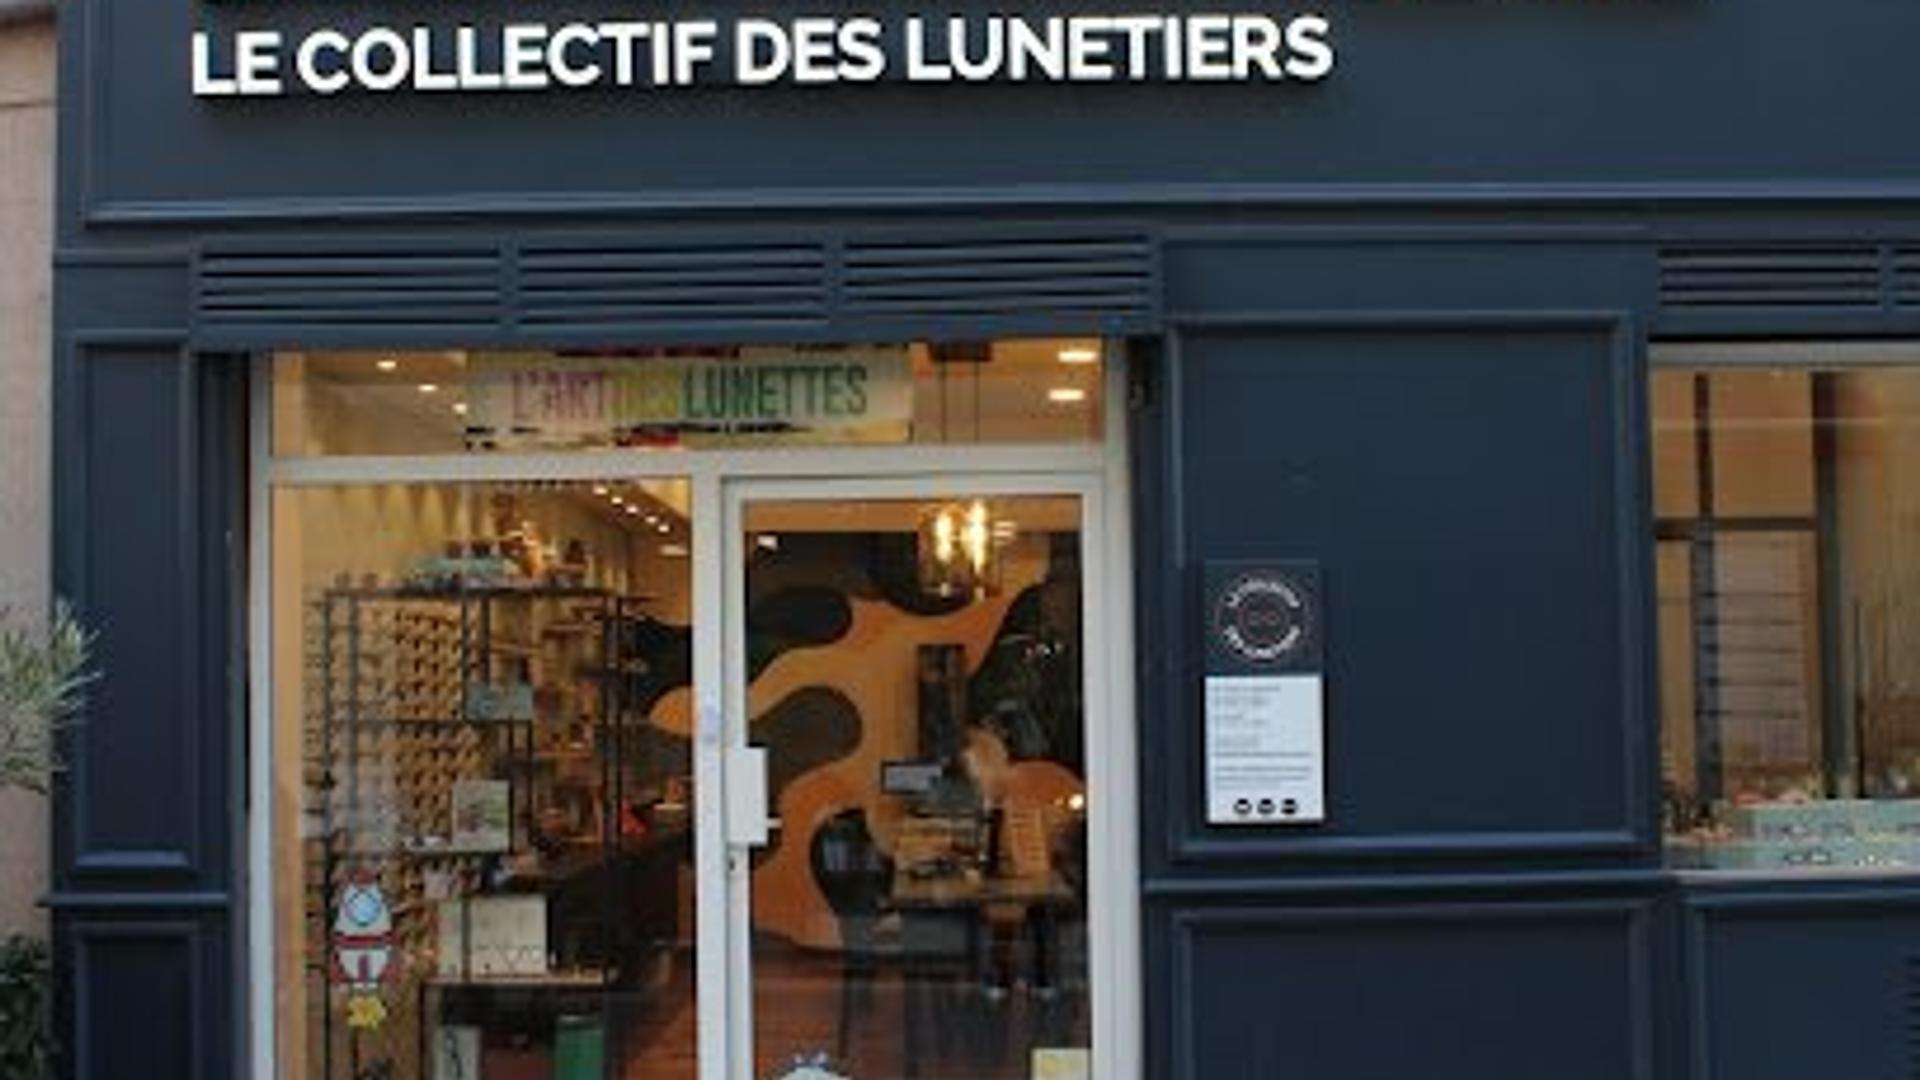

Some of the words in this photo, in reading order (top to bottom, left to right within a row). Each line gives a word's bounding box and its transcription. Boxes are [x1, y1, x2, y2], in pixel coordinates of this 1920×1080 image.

[192, 32, 282, 95] LE
[296, 22, 716, 93] COLLECTIF
[736, 18, 885, 84] DES
[906, 16, 1333, 81] LUNETIERS
